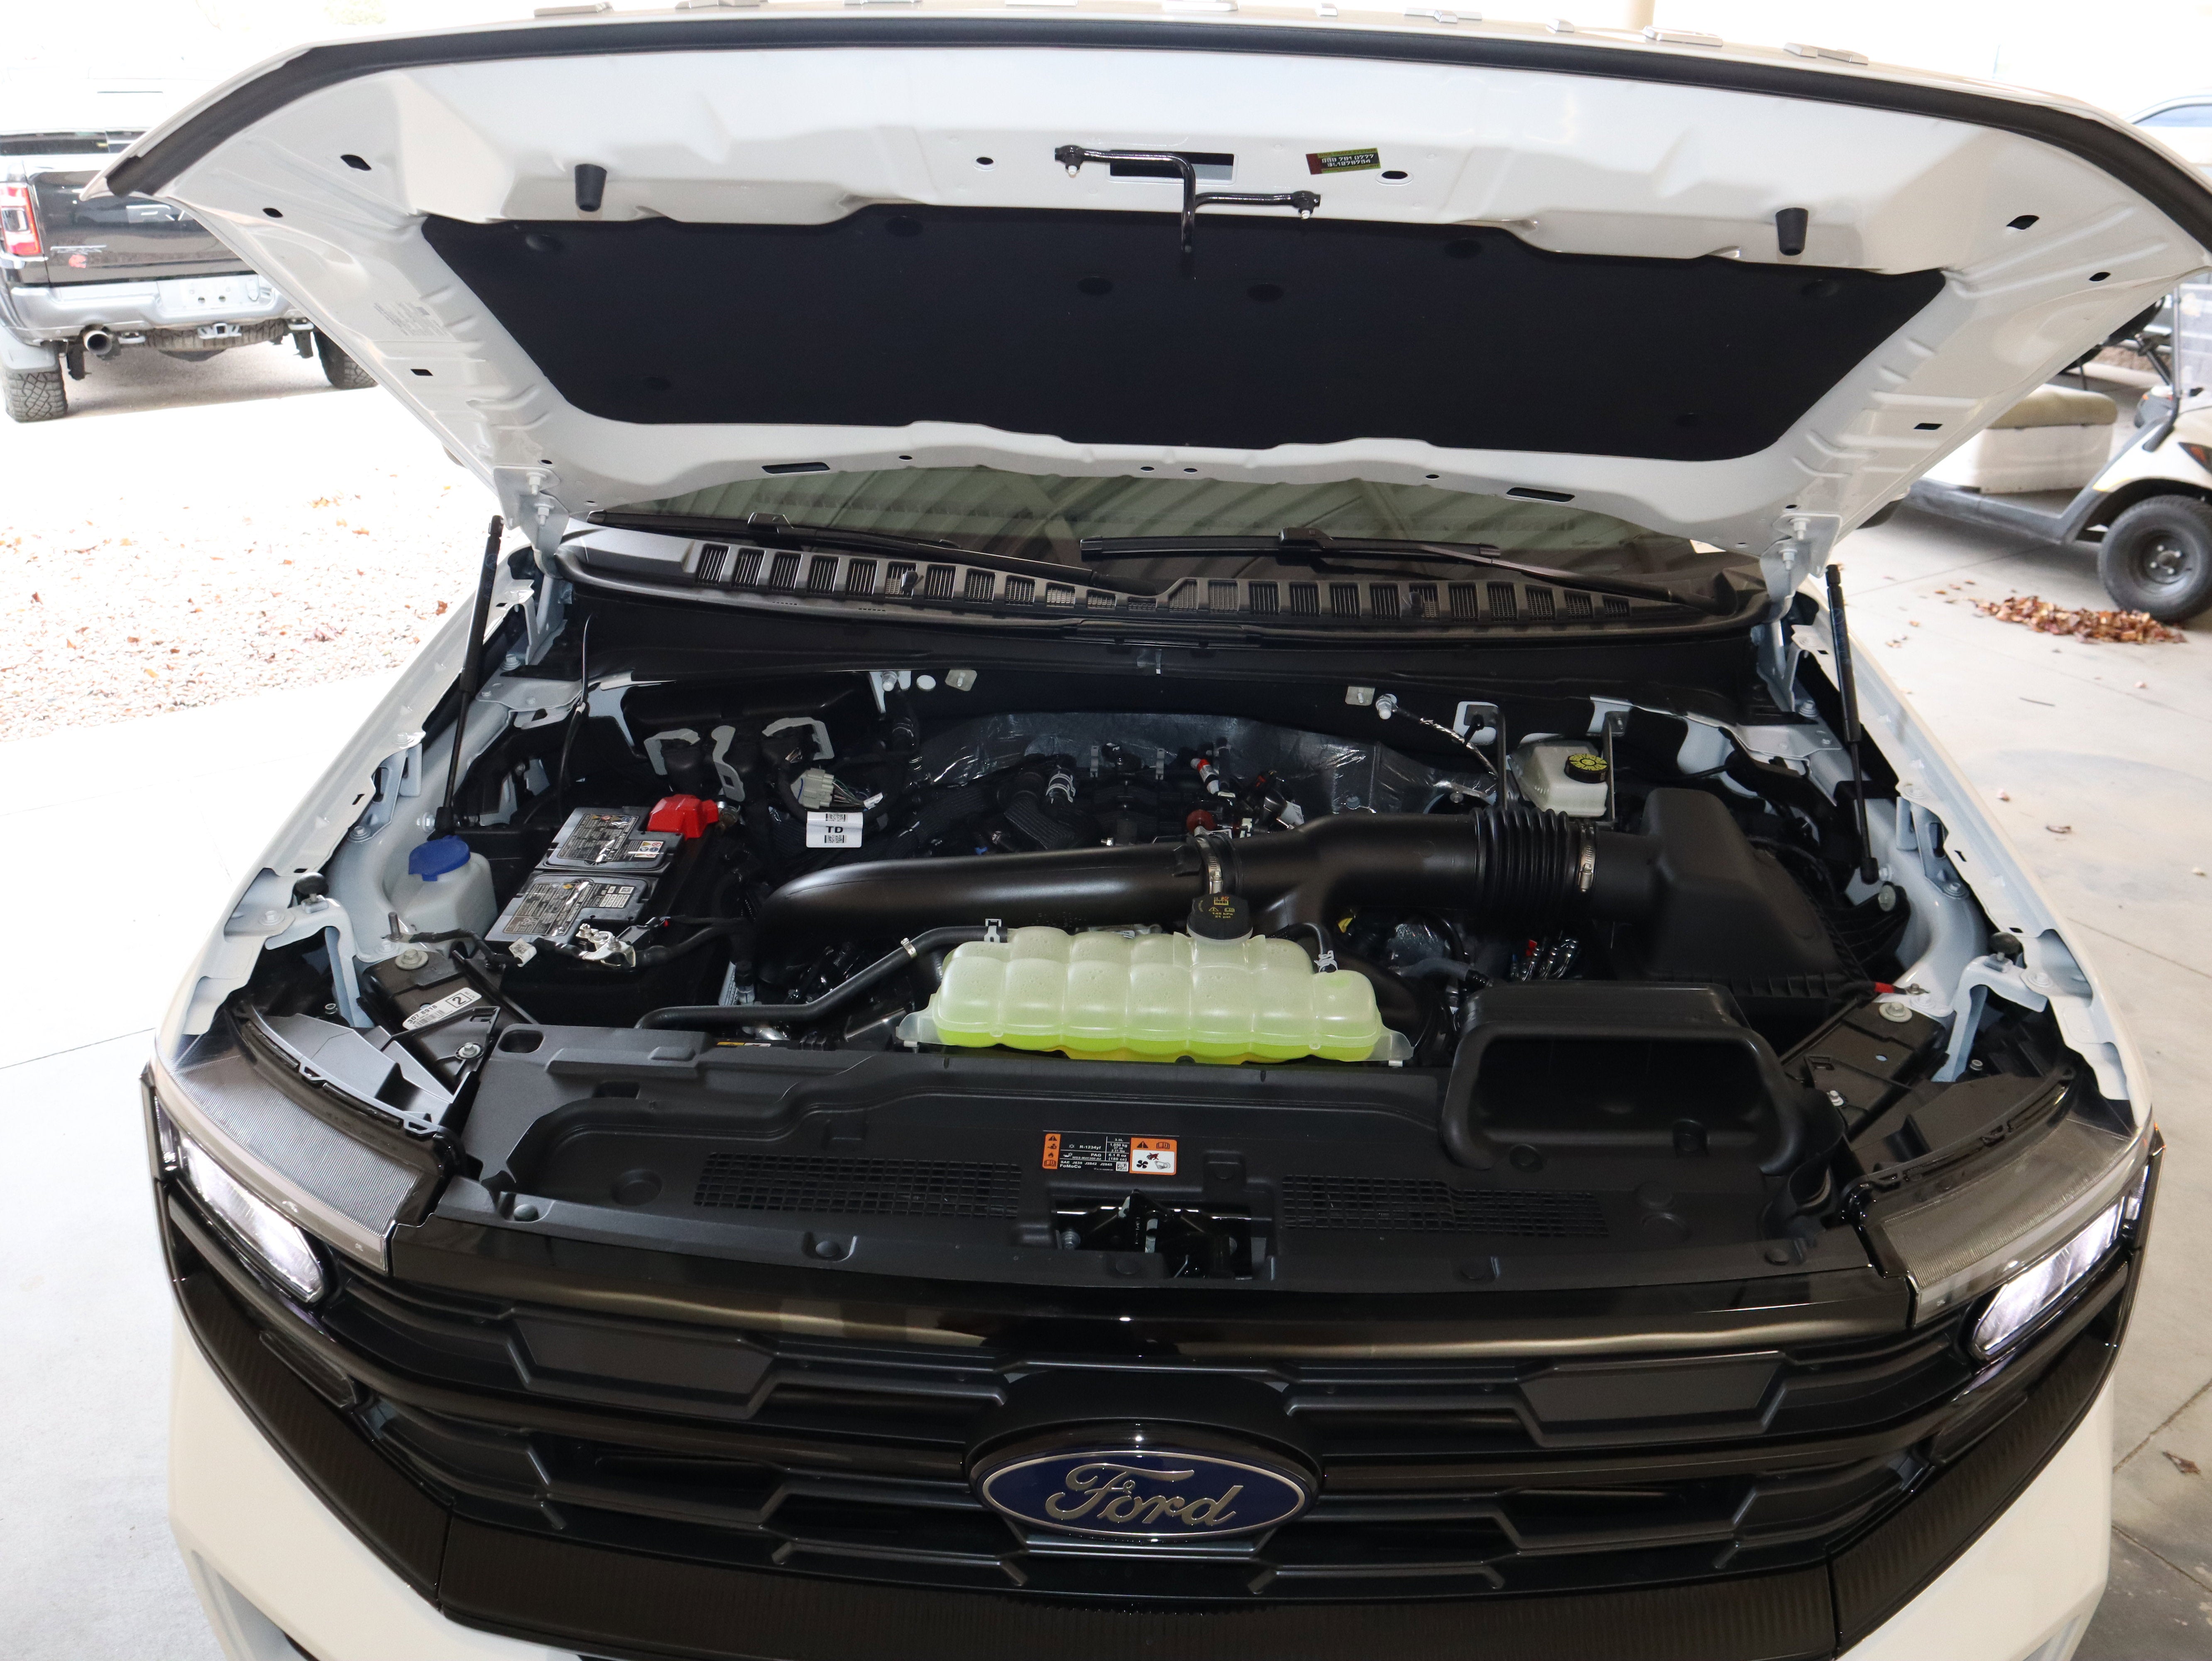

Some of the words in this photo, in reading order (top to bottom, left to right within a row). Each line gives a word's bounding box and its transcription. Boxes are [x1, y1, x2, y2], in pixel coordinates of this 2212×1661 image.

[452, 997, 467, 1005] 2
[407, 1014, 419, 1024] 307
[421, 1005, 438, 1014] 8918
[1045, 1463, 1244, 1526] Ford
